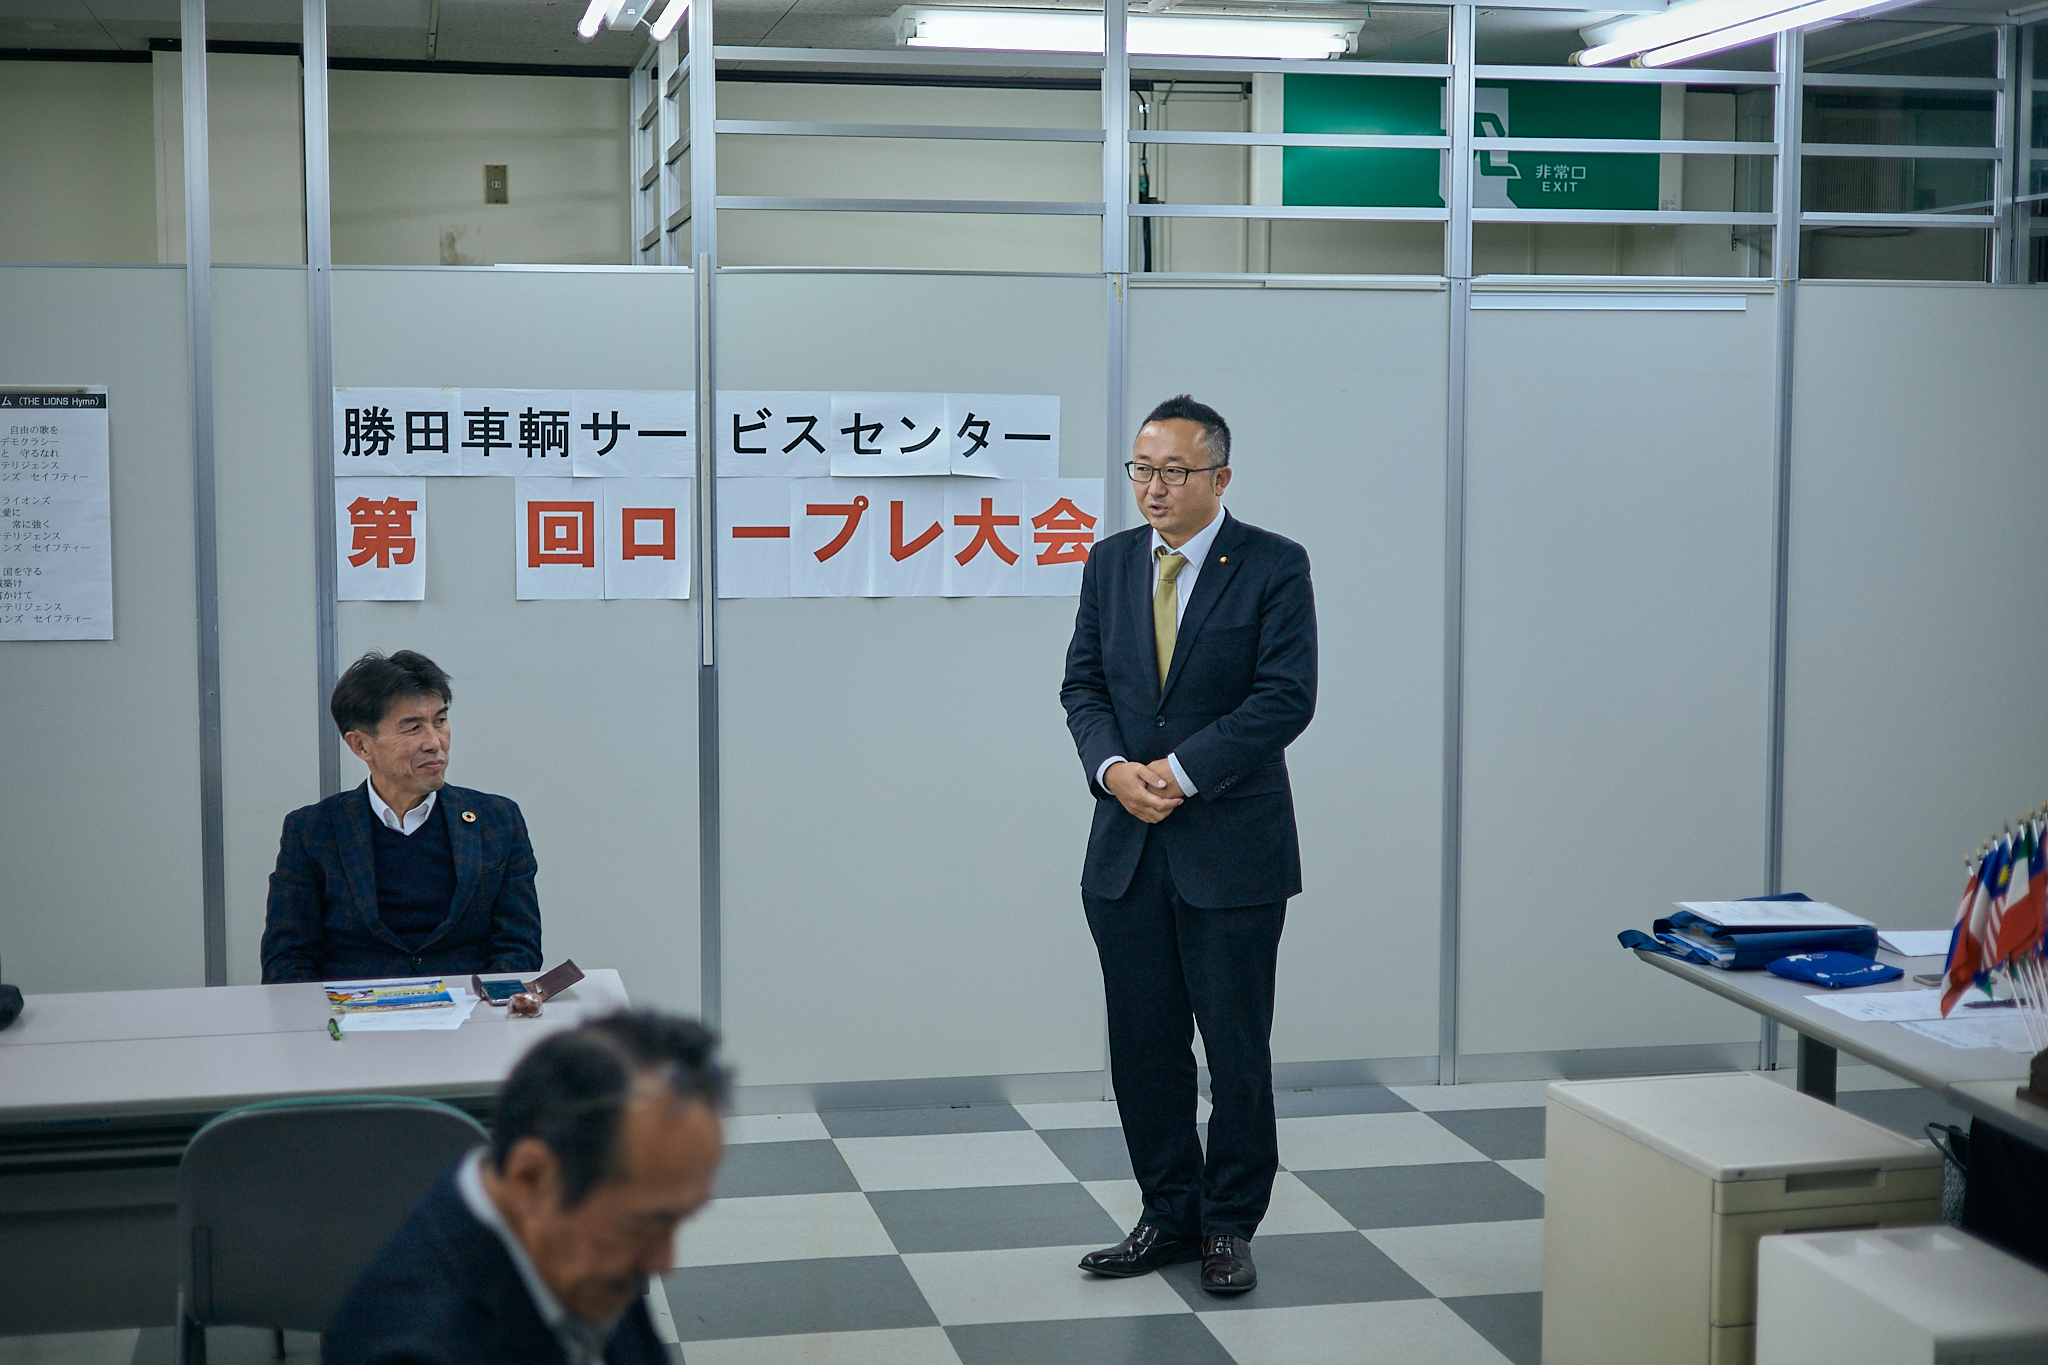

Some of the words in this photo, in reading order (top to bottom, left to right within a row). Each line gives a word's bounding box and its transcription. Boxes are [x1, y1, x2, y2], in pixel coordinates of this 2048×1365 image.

[1535, 164, 1587, 180] 非常口
[1542, 181, 1578, 192] EXIT
[43, 397, 69, 406] LIONS
[10, 425, 58, 435] 自由の歌を
[0, 437, 59, 446] デモクラシー
[20, 449, 59, 459] 守るなれ
[1, 461, 59, 470] テリジェンス
[30, 472, 88, 482] セイフティー
[3, 496, 51, 506] ライオンズ
[0, 508, 21, 518] 愛に
[12, 519, 50, 529] 常に強く
[0, 532, 61, 541] テリジェンス
[348, 496, 418, 569] 第
[32, 543, 91, 553] セイフティー
[3, 567, 42, 577] 国を守る
[0, 579, 23, 588] 築け
[0, 591, 33, 600] かけて
[0, 603, 62, 612] テリジェンス
[0, 614, 24, 624] ンズ
[33, 614, 92, 624] セイフティー
